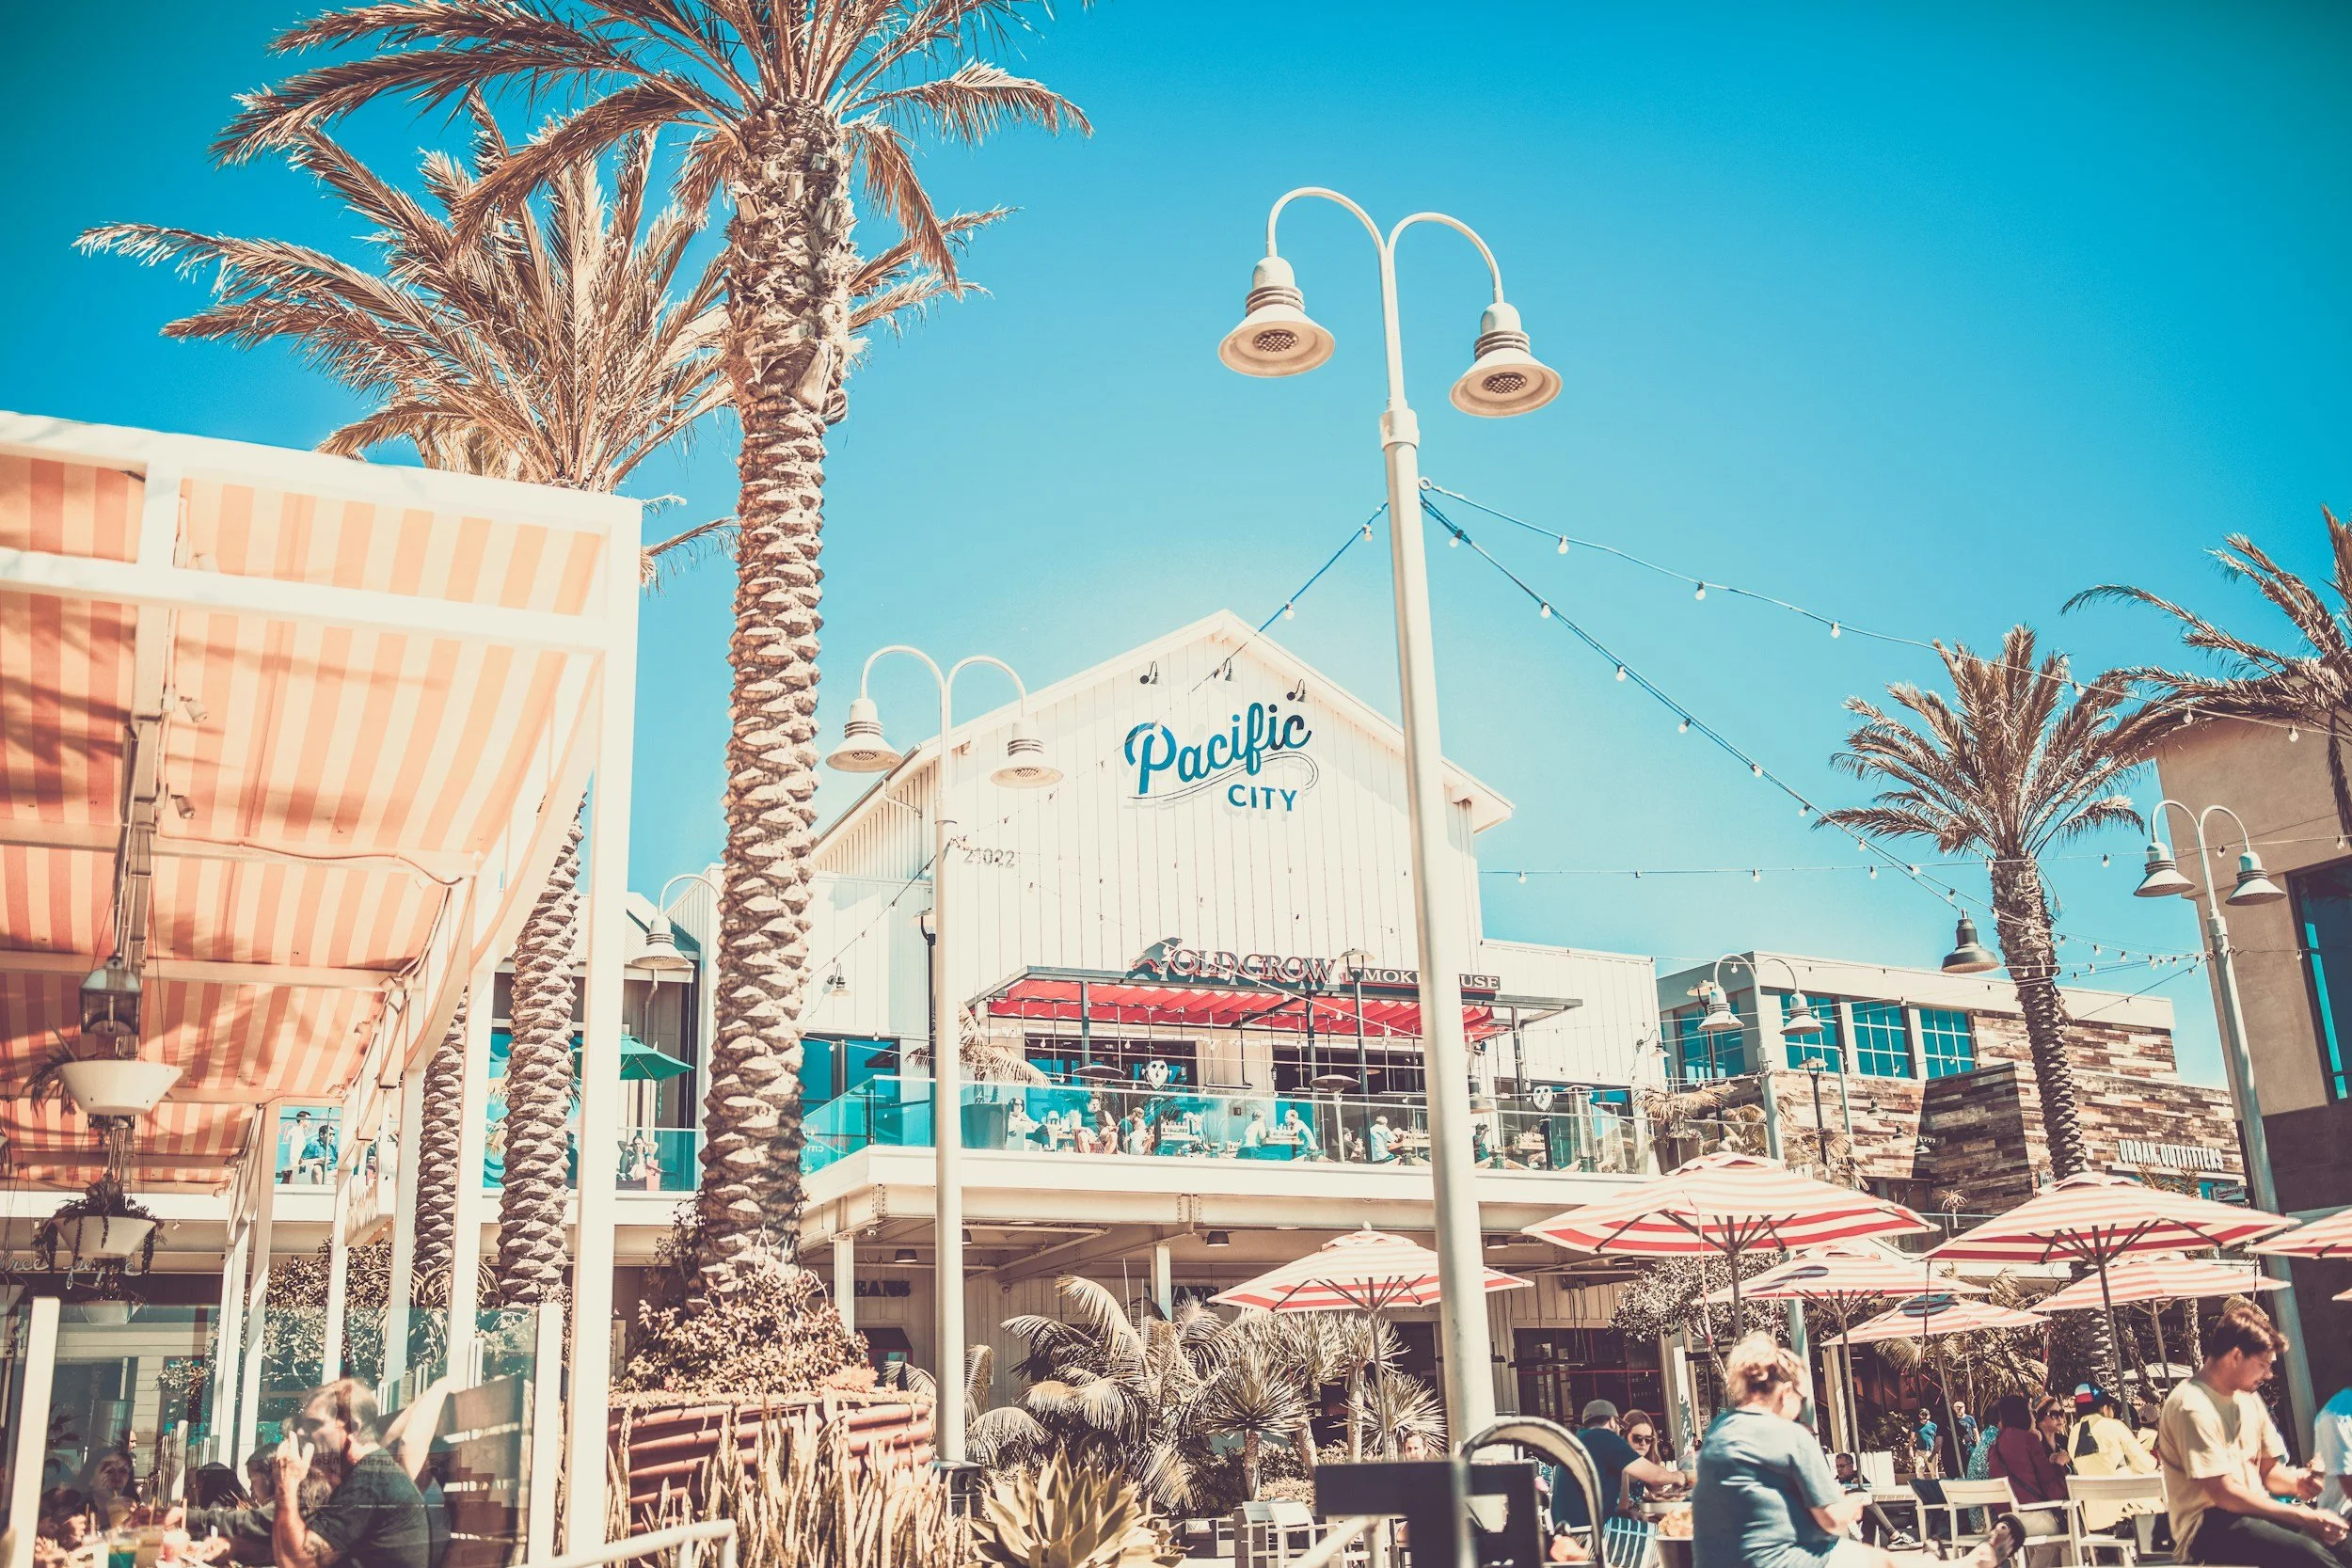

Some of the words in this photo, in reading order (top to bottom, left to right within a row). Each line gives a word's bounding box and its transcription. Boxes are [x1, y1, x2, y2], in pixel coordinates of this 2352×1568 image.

[1124, 703, 1312, 795] Pacific
[1228, 784, 1297, 811] CITY
[1172, 948, 1240, 976] OLD
[1241, 954, 1337, 982] CROW
[1350, 968, 1500, 989] MOKUSE
[2118, 1139, 2160, 1165] URBAN
[2160, 1142, 2224, 1170] OUTFITTERS
